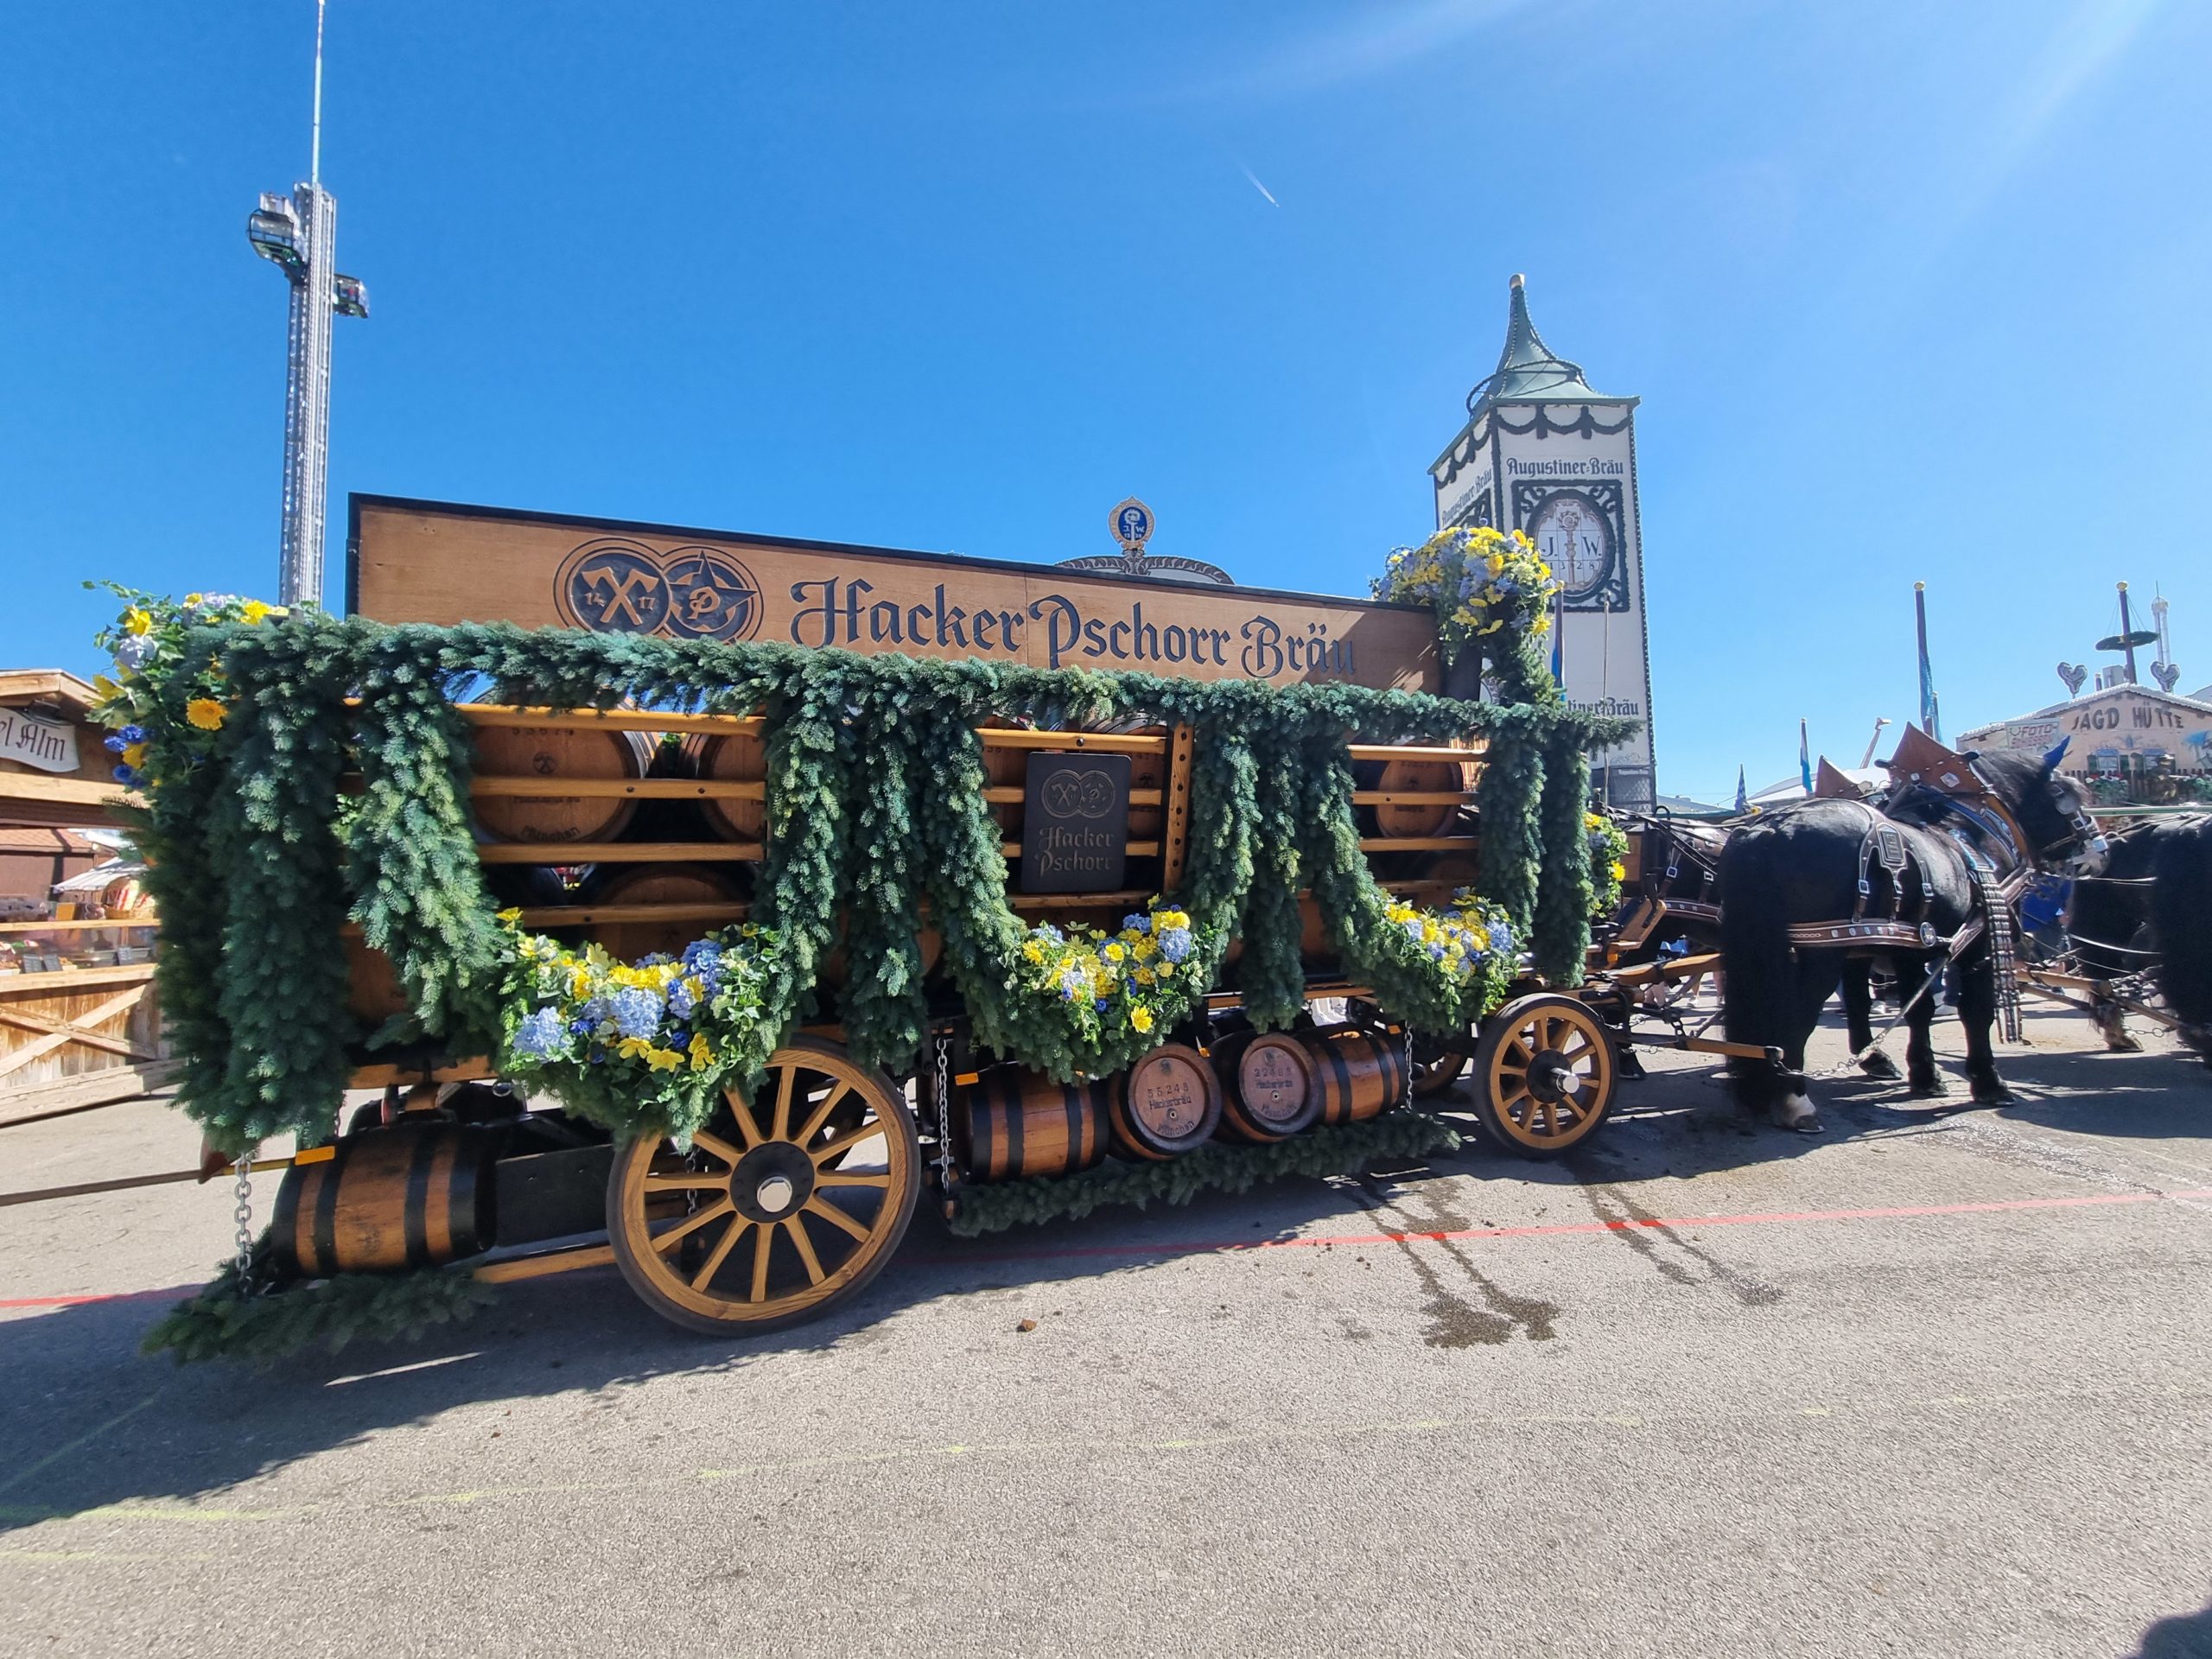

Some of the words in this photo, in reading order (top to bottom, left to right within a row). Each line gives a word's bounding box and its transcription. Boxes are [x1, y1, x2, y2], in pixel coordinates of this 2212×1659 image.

[1541, 537, 1558, 556] J.
[1582, 537, 1602, 556] W.
[790, 576, 1025, 652] Hacker
[1028, 594, 1231, 671] Pschorr
[1240, 614, 1356, 679] Bräu
[2071, 707, 2120, 730] JAGD
[2133, 701, 2184, 728] HÜTTE
[16, 723, 66, 761] Alm
[1039, 826, 1114, 851] Hacker
[1034, 849, 1112, 878] Pschorr
[1147, 1082, 1189, 1098] 55248
